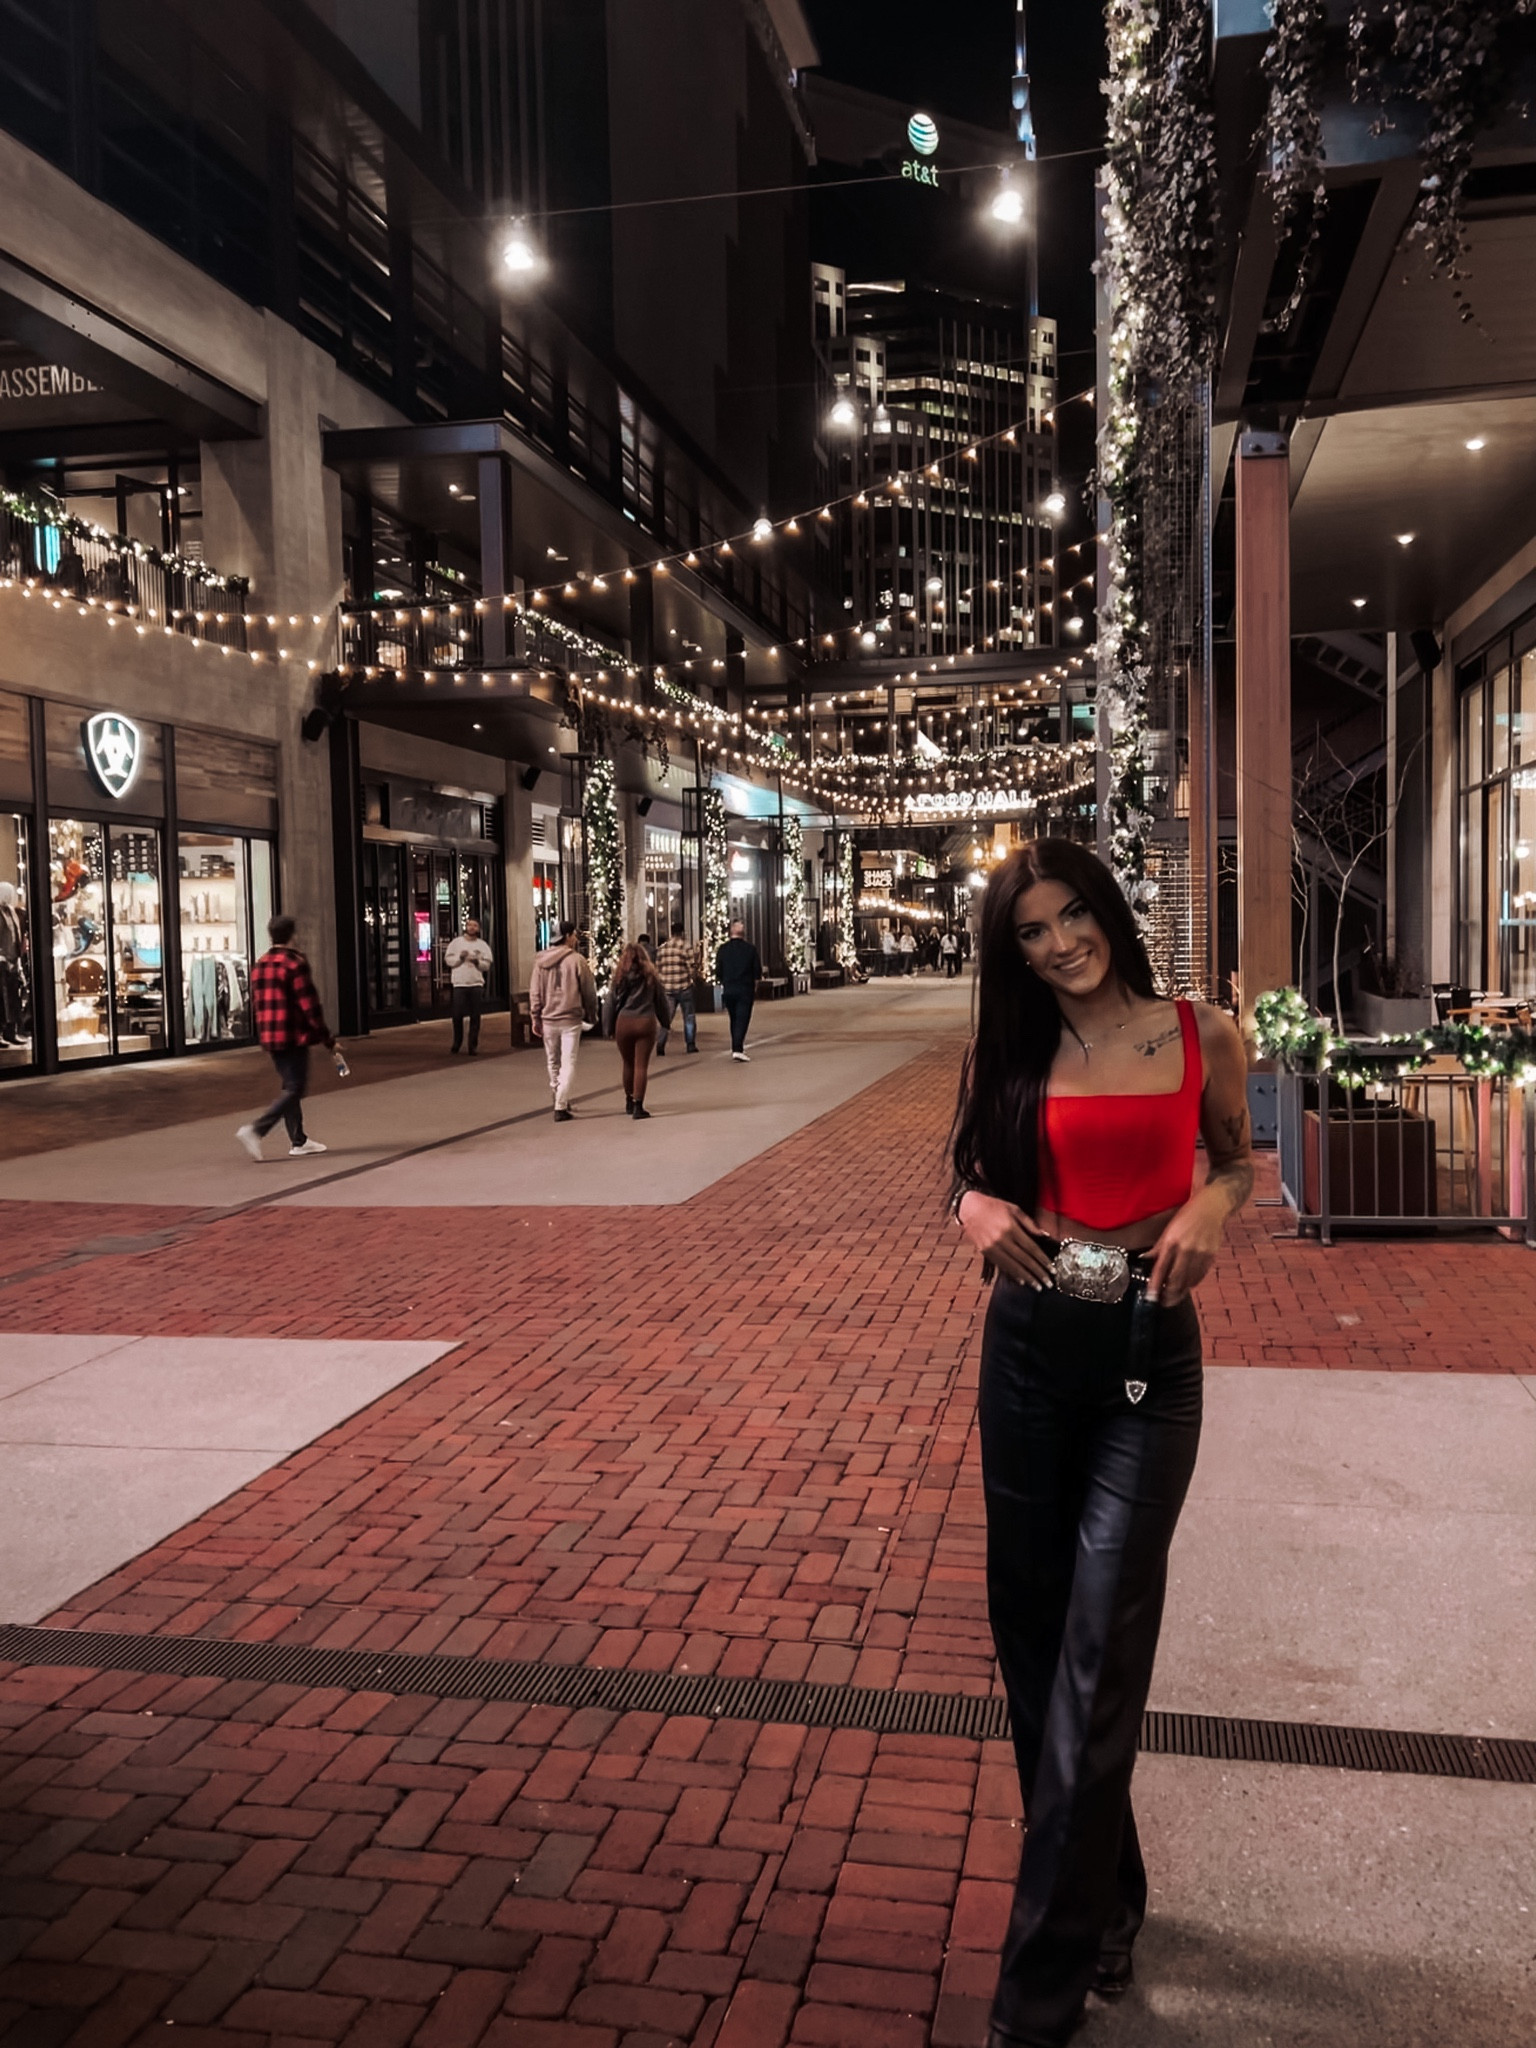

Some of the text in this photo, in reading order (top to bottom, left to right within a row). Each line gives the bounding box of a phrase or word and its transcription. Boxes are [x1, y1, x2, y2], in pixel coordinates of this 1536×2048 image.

[902, 159, 939, 188] at&t
[917, 789, 1037, 809] FOOD HALL
[863, 869, 892, 879] SHAKE
[863, 878, 893, 888] SHACK
